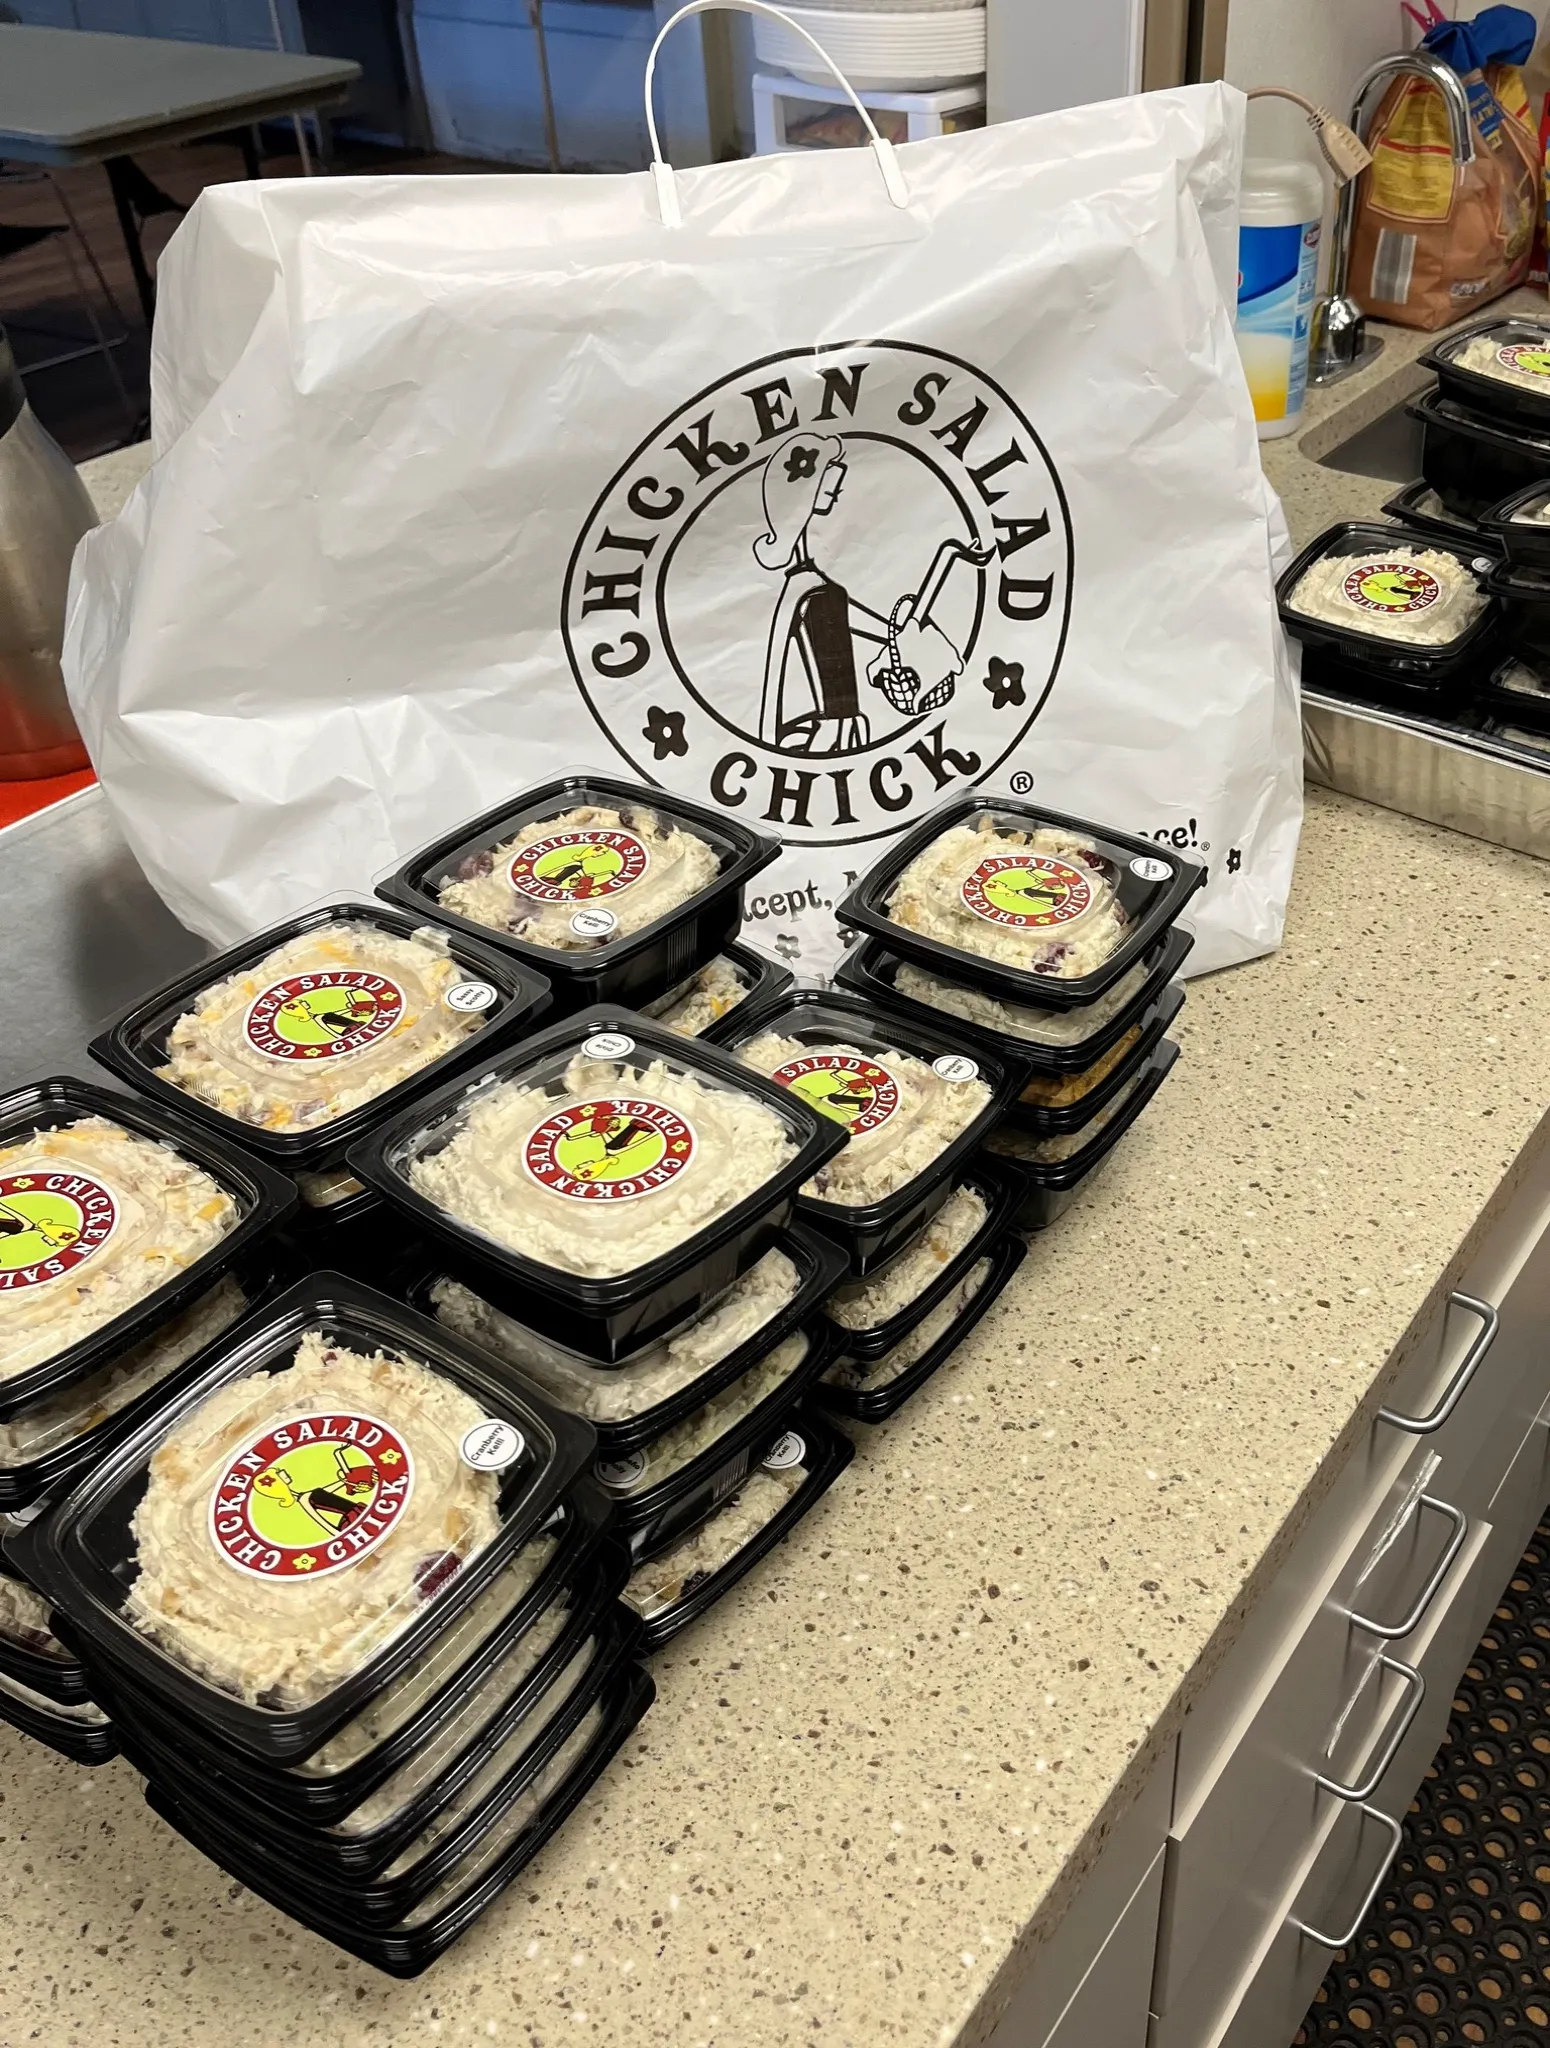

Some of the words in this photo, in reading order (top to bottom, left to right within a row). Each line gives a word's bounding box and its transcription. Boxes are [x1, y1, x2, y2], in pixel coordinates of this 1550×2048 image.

[580, 362, 870, 680] CHICKEN
[896, 371, 1055, 621] SALAD
[1345, 574, 1388, 612] CHICKEN
[1408, 583, 1438, 610] CHICK
[710, 718, 981, 828] CHICK
[522, 832, 627, 861] CHICKEN
[611, 844, 645, 889] SALAD
[983, 857, 1056, 873] SALAD
[515, 873, 578, 901] CHICK
[1053, 881, 1088, 920] CHICK
[301, 973, 386, 992] SALAD
[249, 985, 297, 1057] CHICKEN
[330, 1003, 401, 1054] CHICK
[780, 1057, 861, 1079] SALAD
[608, 1100, 686, 1138] CHICK
[859, 1077, 896, 1128] CHICK
[529, 1114, 574, 1174] SALAD
[551, 1157, 683, 1198] CHICKEN
[45, 1175, 112, 1256] CHICKEN
[275, 1418, 384, 1449] SALAD
[470, 1424, 504, 1461] Cranberry
[487, 1437, 506, 1456] Kelli
[217, 1450, 281, 1571] CHICKEN
[327, 1471, 410, 1560] CHICK
